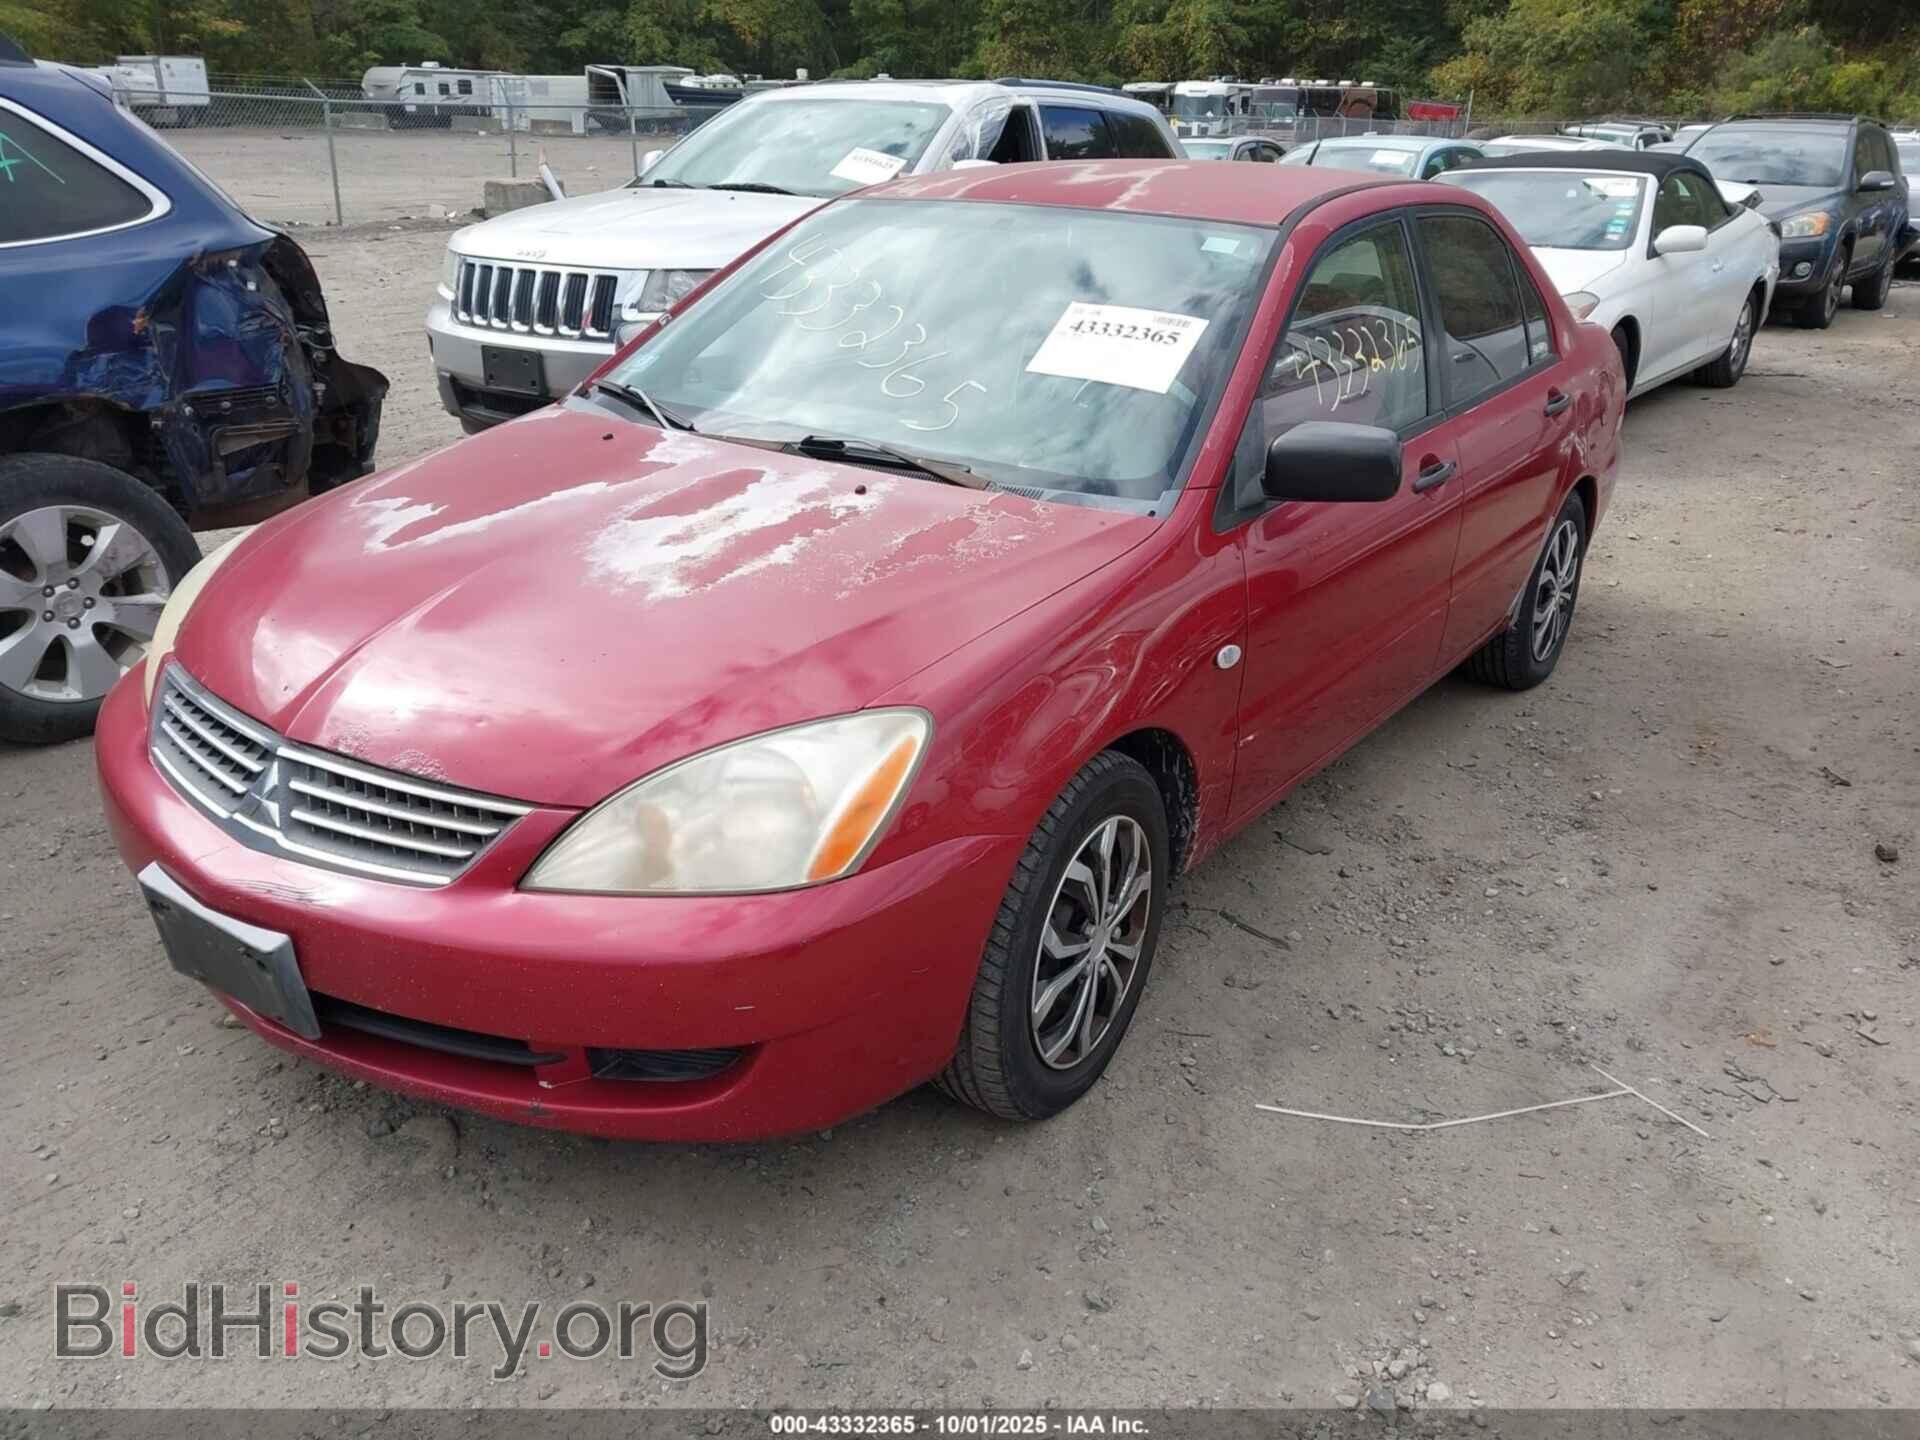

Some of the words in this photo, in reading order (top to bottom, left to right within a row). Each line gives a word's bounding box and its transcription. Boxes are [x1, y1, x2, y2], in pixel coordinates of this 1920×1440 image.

[760, 233, 987, 431] 43332365
[1069, 319, 1181, 345] 43332365
[1292, 315, 1420, 412] 43332365
